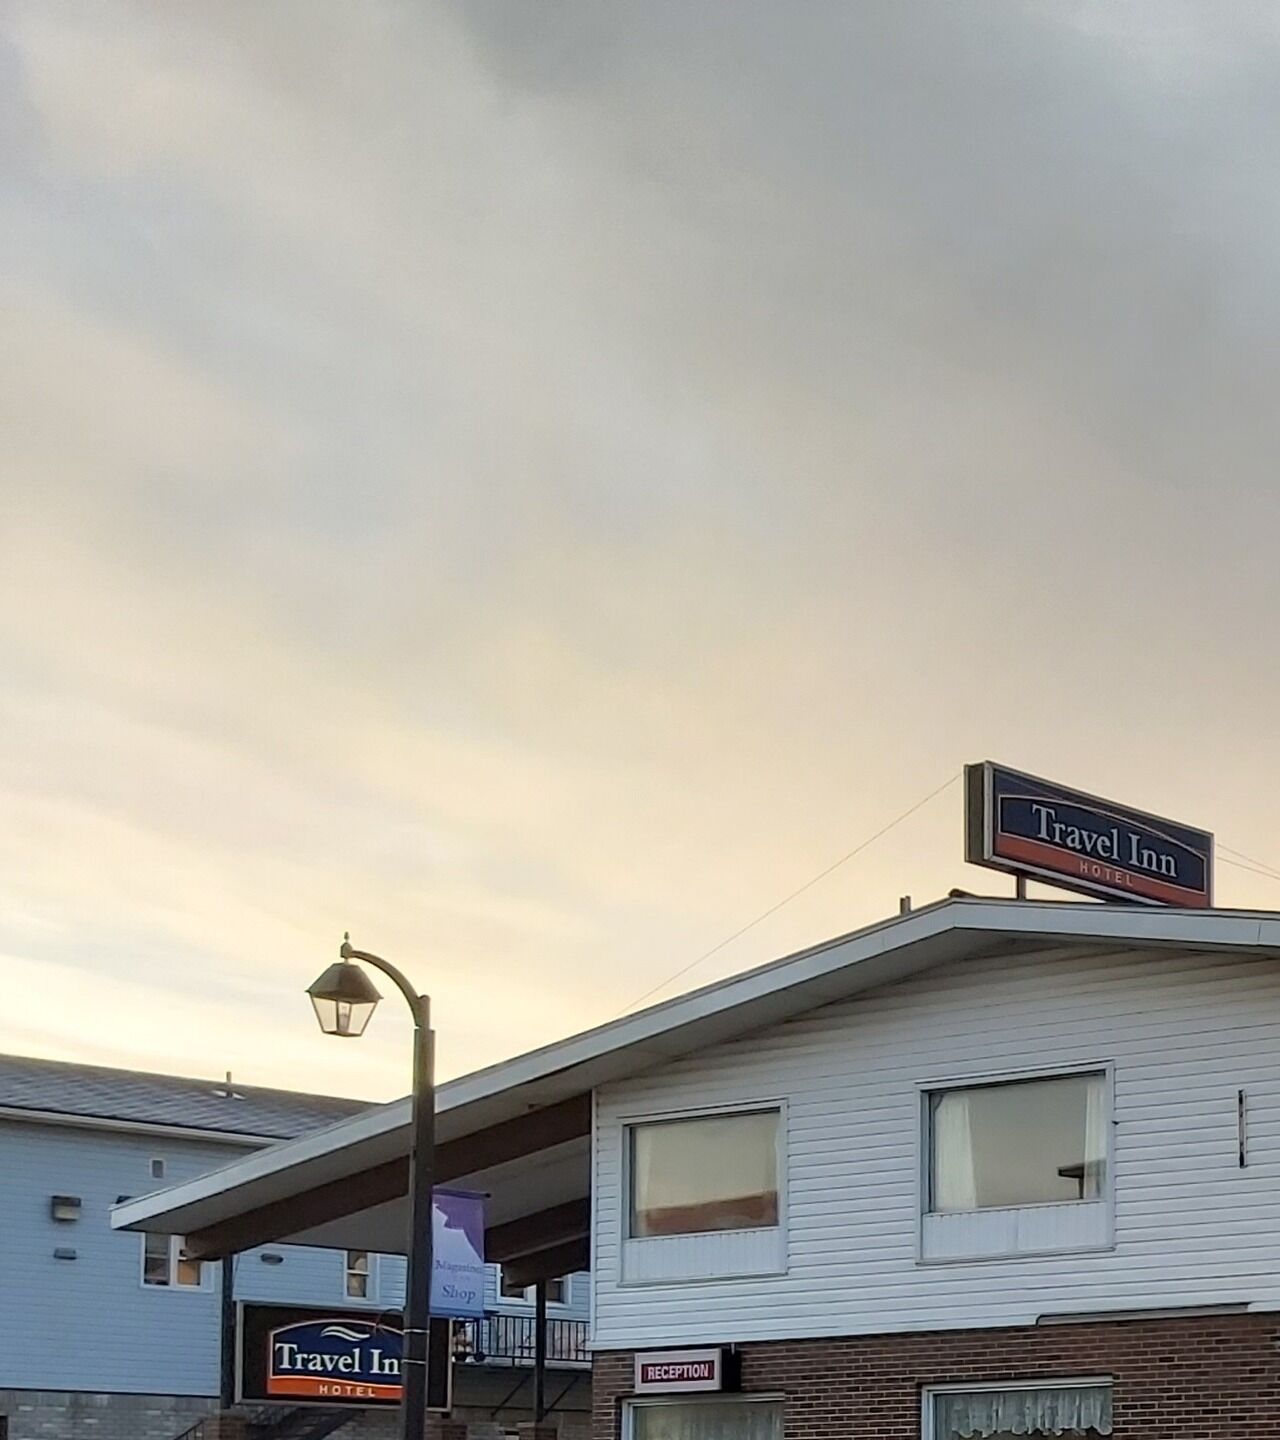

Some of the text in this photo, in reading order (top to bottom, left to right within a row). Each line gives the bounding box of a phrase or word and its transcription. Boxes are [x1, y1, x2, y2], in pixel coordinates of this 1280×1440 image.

[1032, 803, 1177, 877] Travel Inn
[1079, 860, 1133, 886] HOTEL
[442, 1284, 476, 1304] Shop
[275, 1343, 401, 1375] Travel In
[647, 1363, 709, 1380] RECEPTION
[319, 1384, 376, 1397] HOTEL
